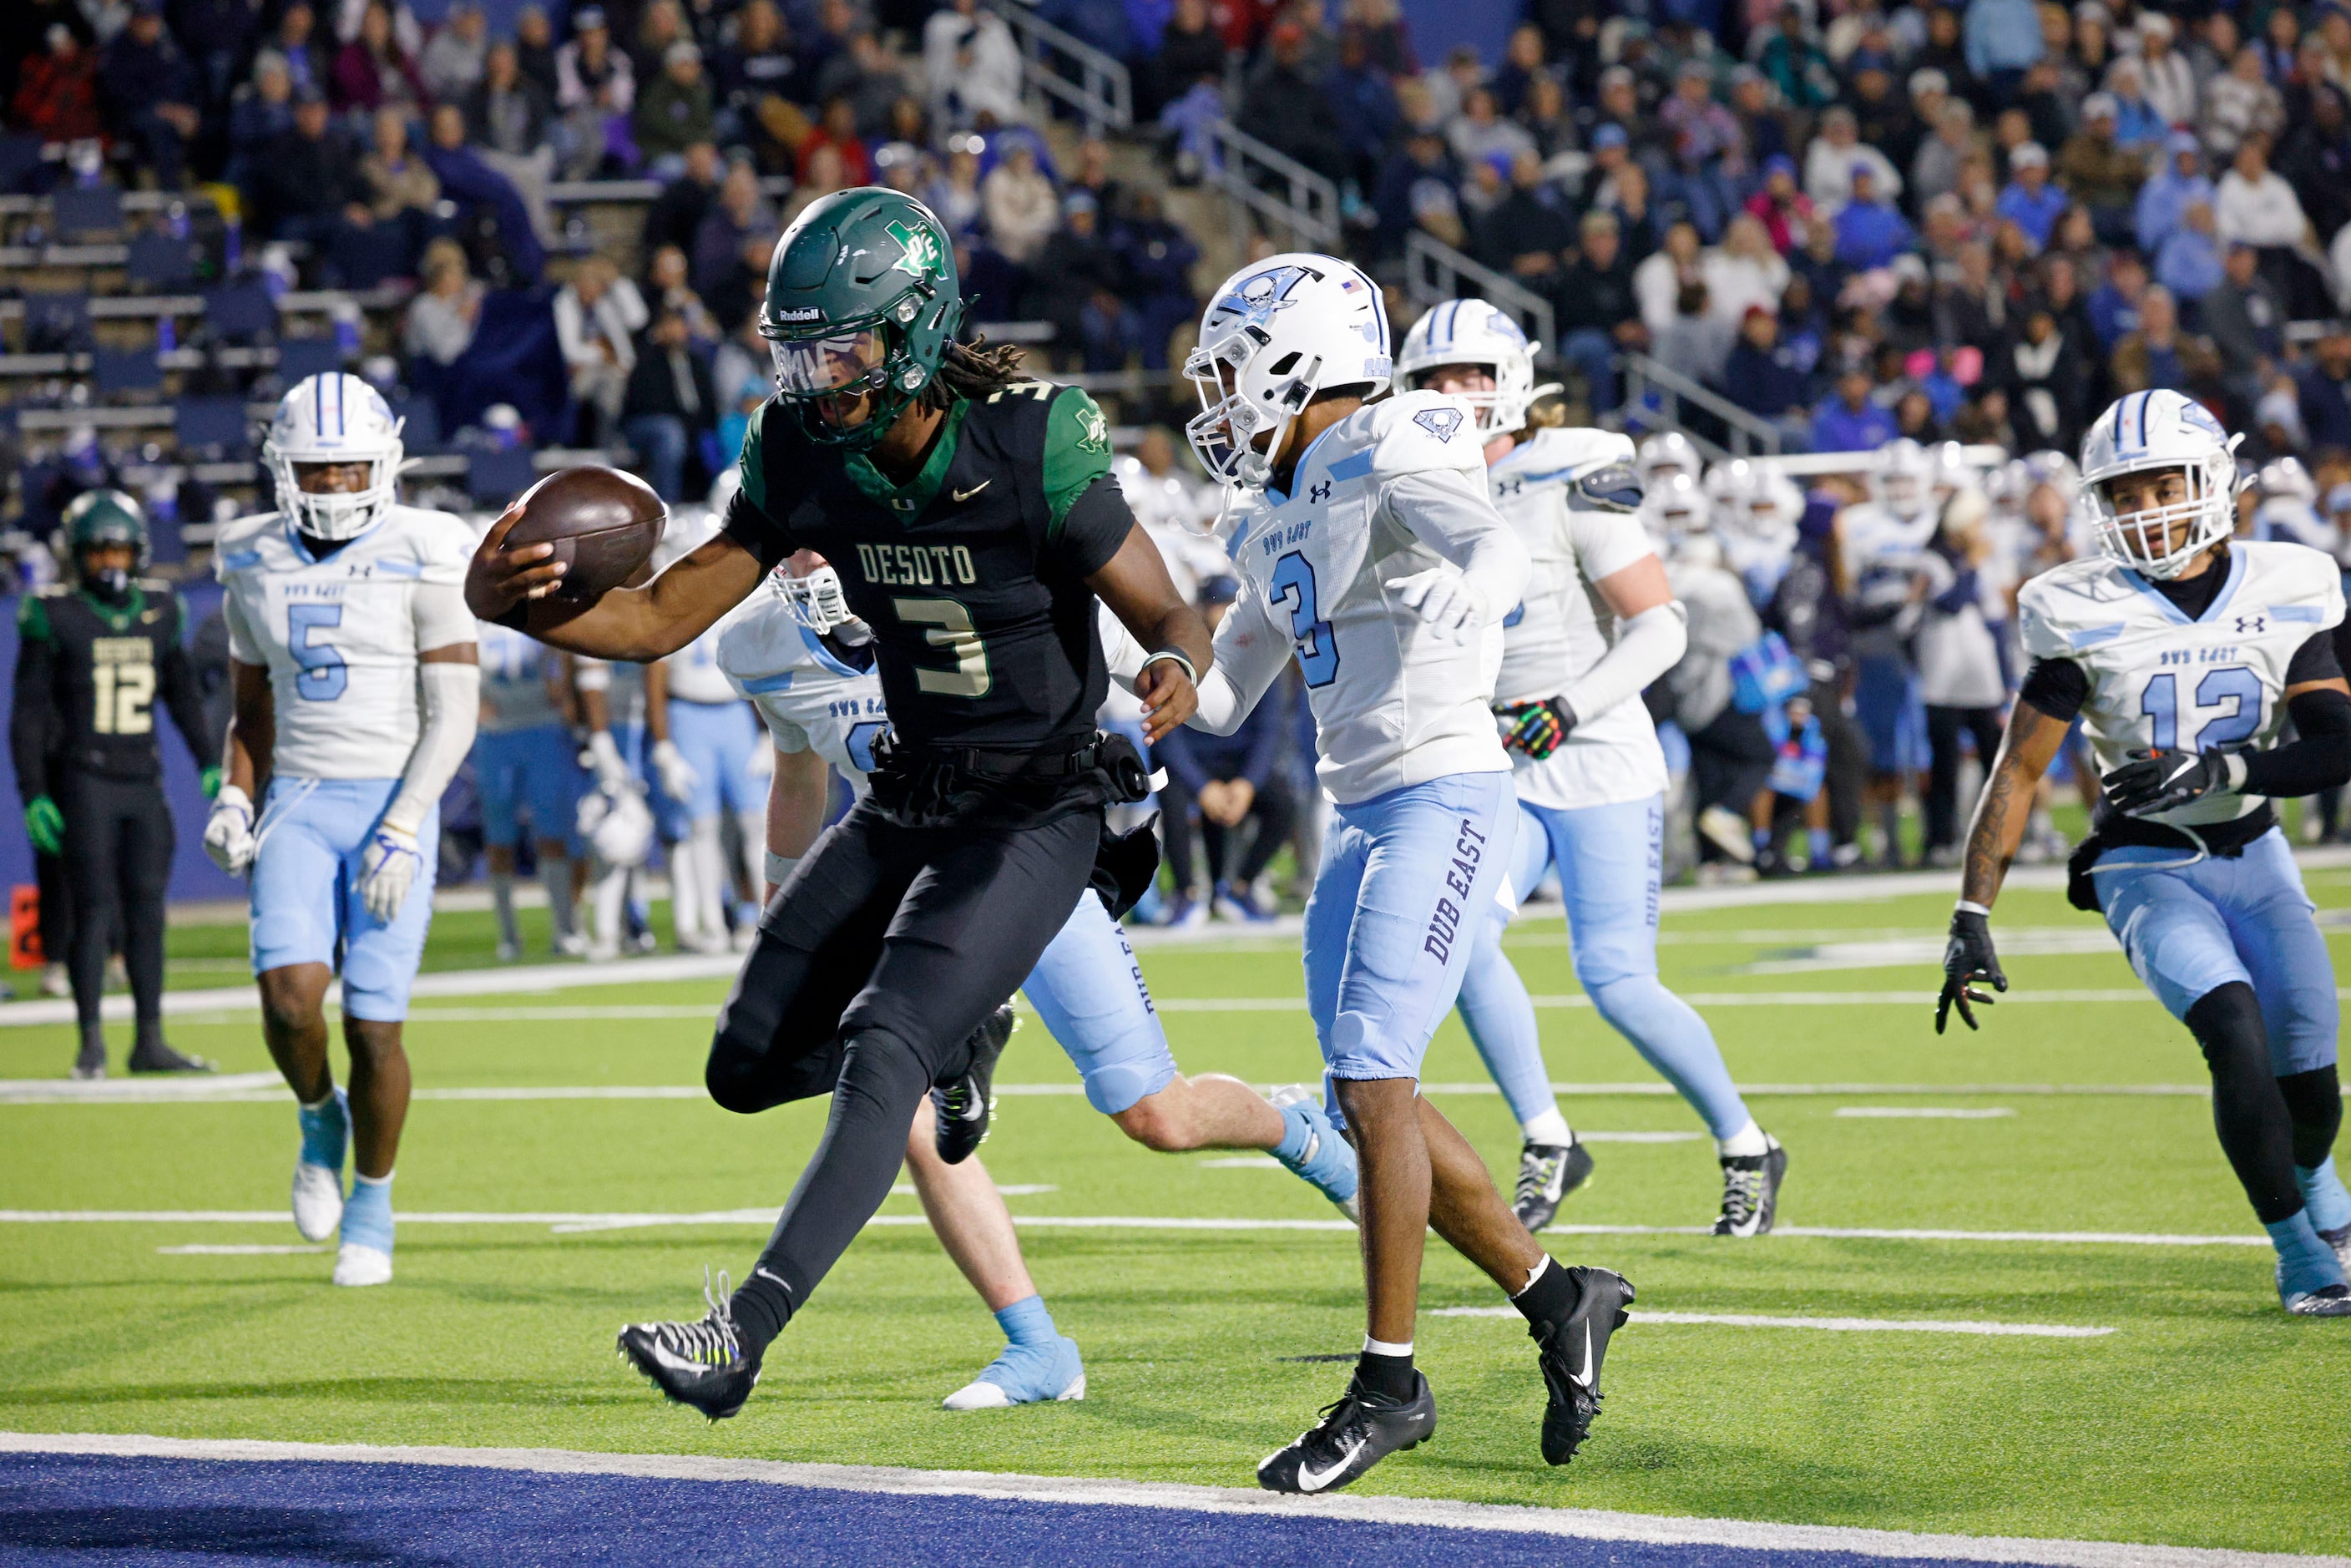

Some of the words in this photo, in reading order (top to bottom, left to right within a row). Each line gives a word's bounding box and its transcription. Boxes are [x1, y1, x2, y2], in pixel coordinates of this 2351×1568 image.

[780, 308, 819, 321] Riddell
[856, 544, 977, 585] DESOTO
[287, 603, 348, 702] 5
[890, 595, 993, 700] 3
[1269, 549, 1341, 690] 3
[92, 663, 156, 735] 12
[2141, 666, 2263, 756] 12
[1647, 807, 1662, 870] EAST
[1423, 897, 1461, 967] DUB
[1446, 818, 1486, 901] EAST
